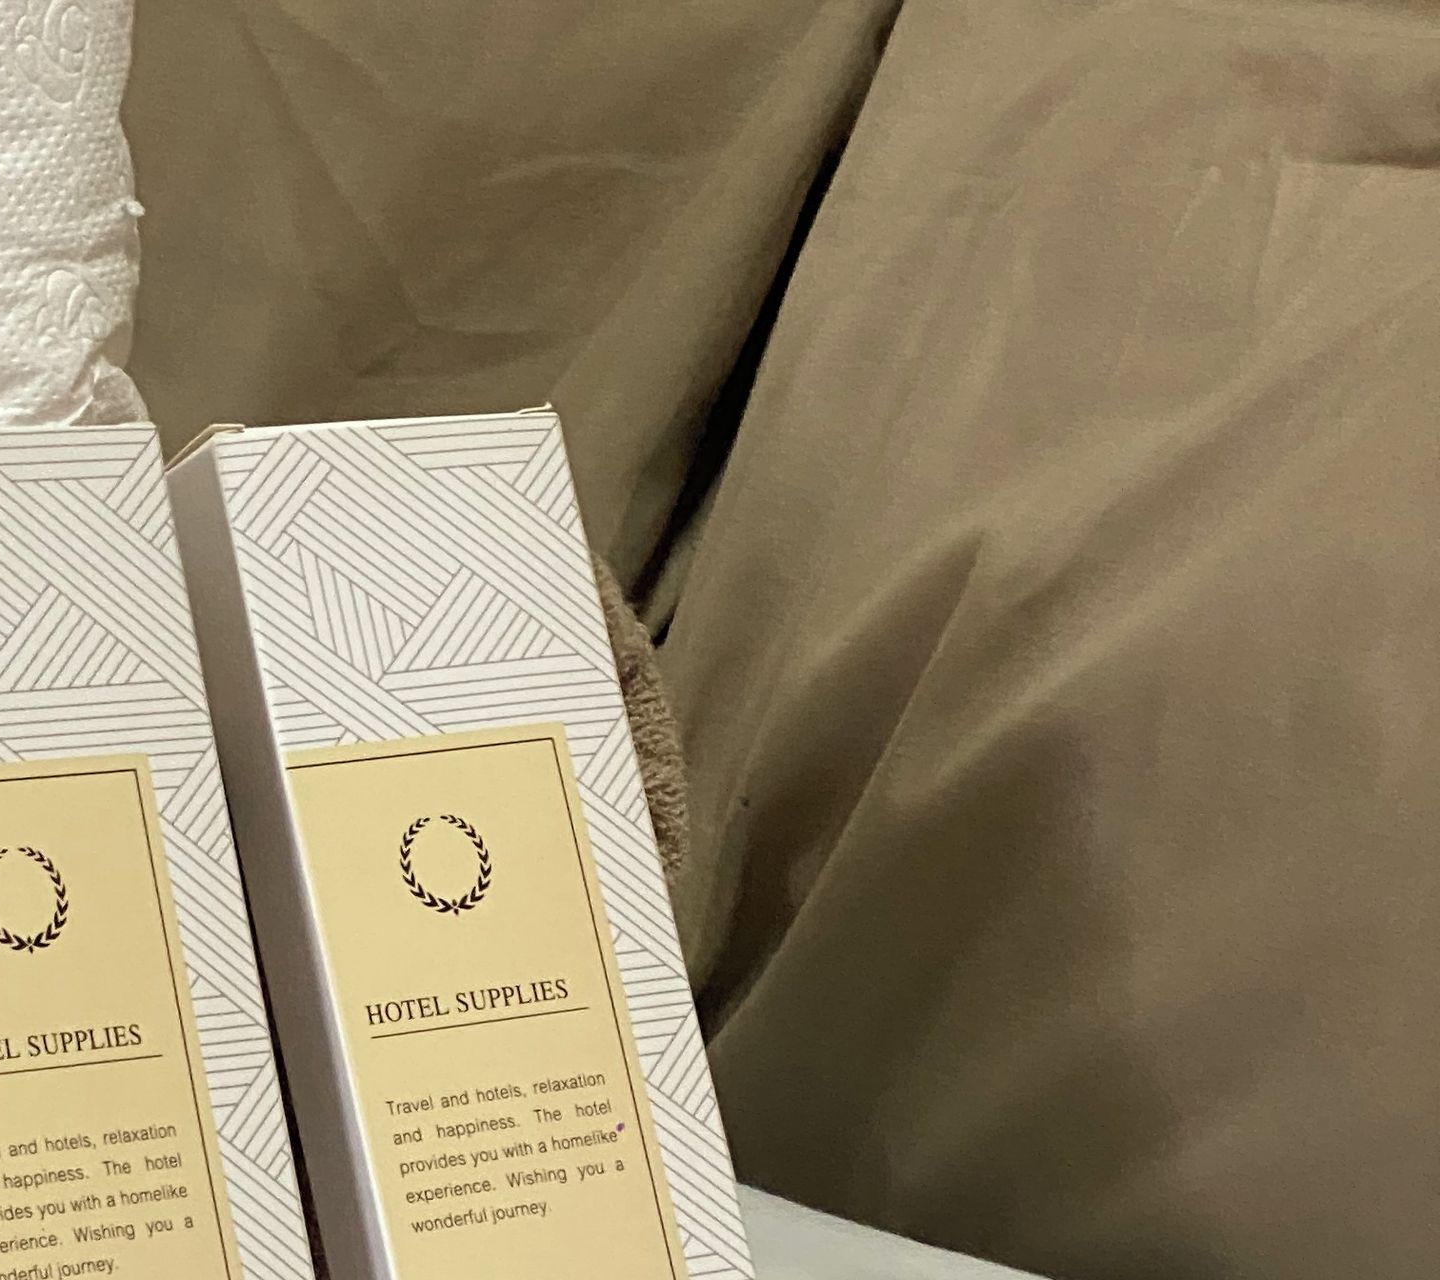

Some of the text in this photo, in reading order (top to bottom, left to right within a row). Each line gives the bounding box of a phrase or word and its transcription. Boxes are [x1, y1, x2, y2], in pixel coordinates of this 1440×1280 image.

[365, 978, 571, 1027] HOTEL SUPPLIES
[26, 1022, 144, 1058] SUPPLIES
[385, 1094, 435, 1117] Travel
[440, 1090, 470, 1111] and
[532, 1071, 607, 1096] relaxation
[7, 1137, 39, 1159] and
[101, 1122, 177, 1147] relaxation
[392, 1127, 423, 1147] and
[533, 1107, 563, 1124] The
[574, 1099, 613, 1119] hotel
[101, 1159, 132, 1178] The
[144, 1152, 183, 1173] hotel
[399, 1128, 620, 1179] provides you with a homelike
[505, 1167, 568, 1190] Wishing
[576, 1161, 606, 1183] you
[614, 1158, 626, 1173] a
[36, 1199, 67, 1219] you
[69, 1193, 103, 1214] with
[106, 1195, 117, 1209] a
[119, 1183, 189, 1208] homelike
[73, 1220, 136, 1245] Wishing
[145, 1216, 174, 1239] you
[183, 1216, 194, 1230] a
[410, 1208, 489, 1236] wonderful
